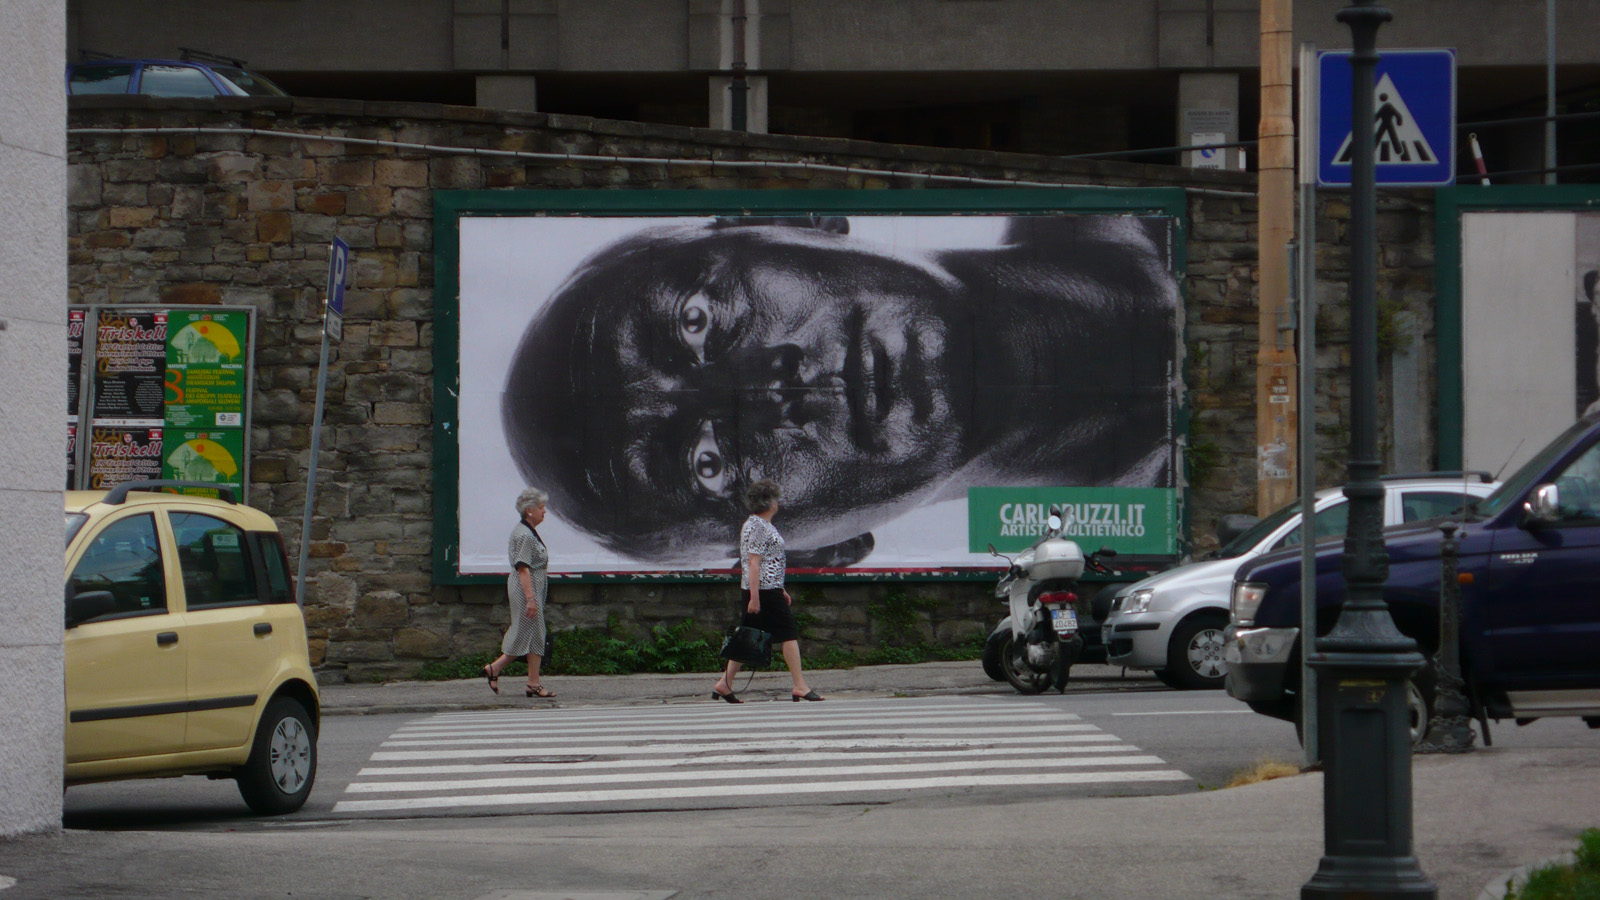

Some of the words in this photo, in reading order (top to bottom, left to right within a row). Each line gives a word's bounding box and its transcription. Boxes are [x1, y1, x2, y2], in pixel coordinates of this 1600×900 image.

[332, 245, 344, 302] P
[98, 325, 166, 341] Triskell
[94, 442, 162, 456] Triskell
[1062, 524, 1145, 536] ULTIETNICO
